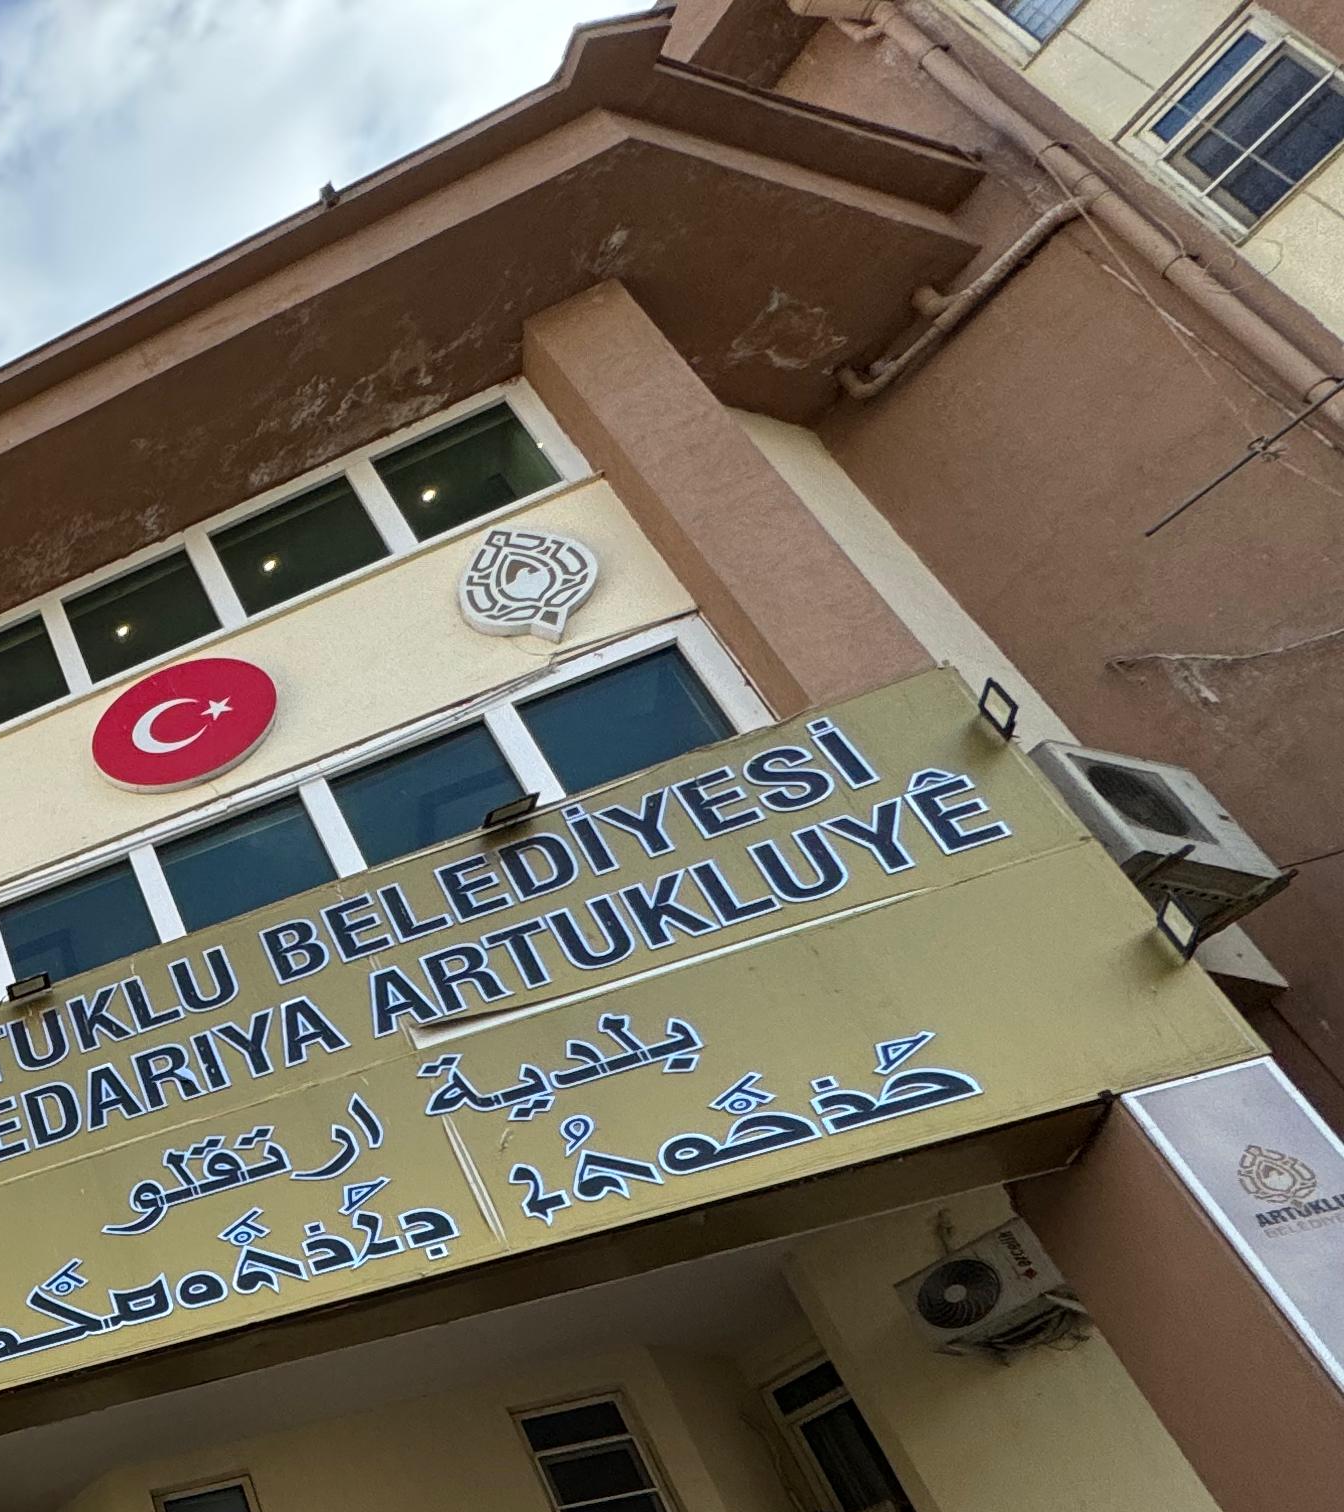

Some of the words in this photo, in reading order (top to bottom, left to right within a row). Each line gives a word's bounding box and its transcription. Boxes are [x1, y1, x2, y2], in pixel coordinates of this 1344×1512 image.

[258, 718, 880, 985] BELEDİYESİ
[369, 767, 1012, 1039] ARTUKLUYÊ
[420, 1013, 703, 1120] بلدية
